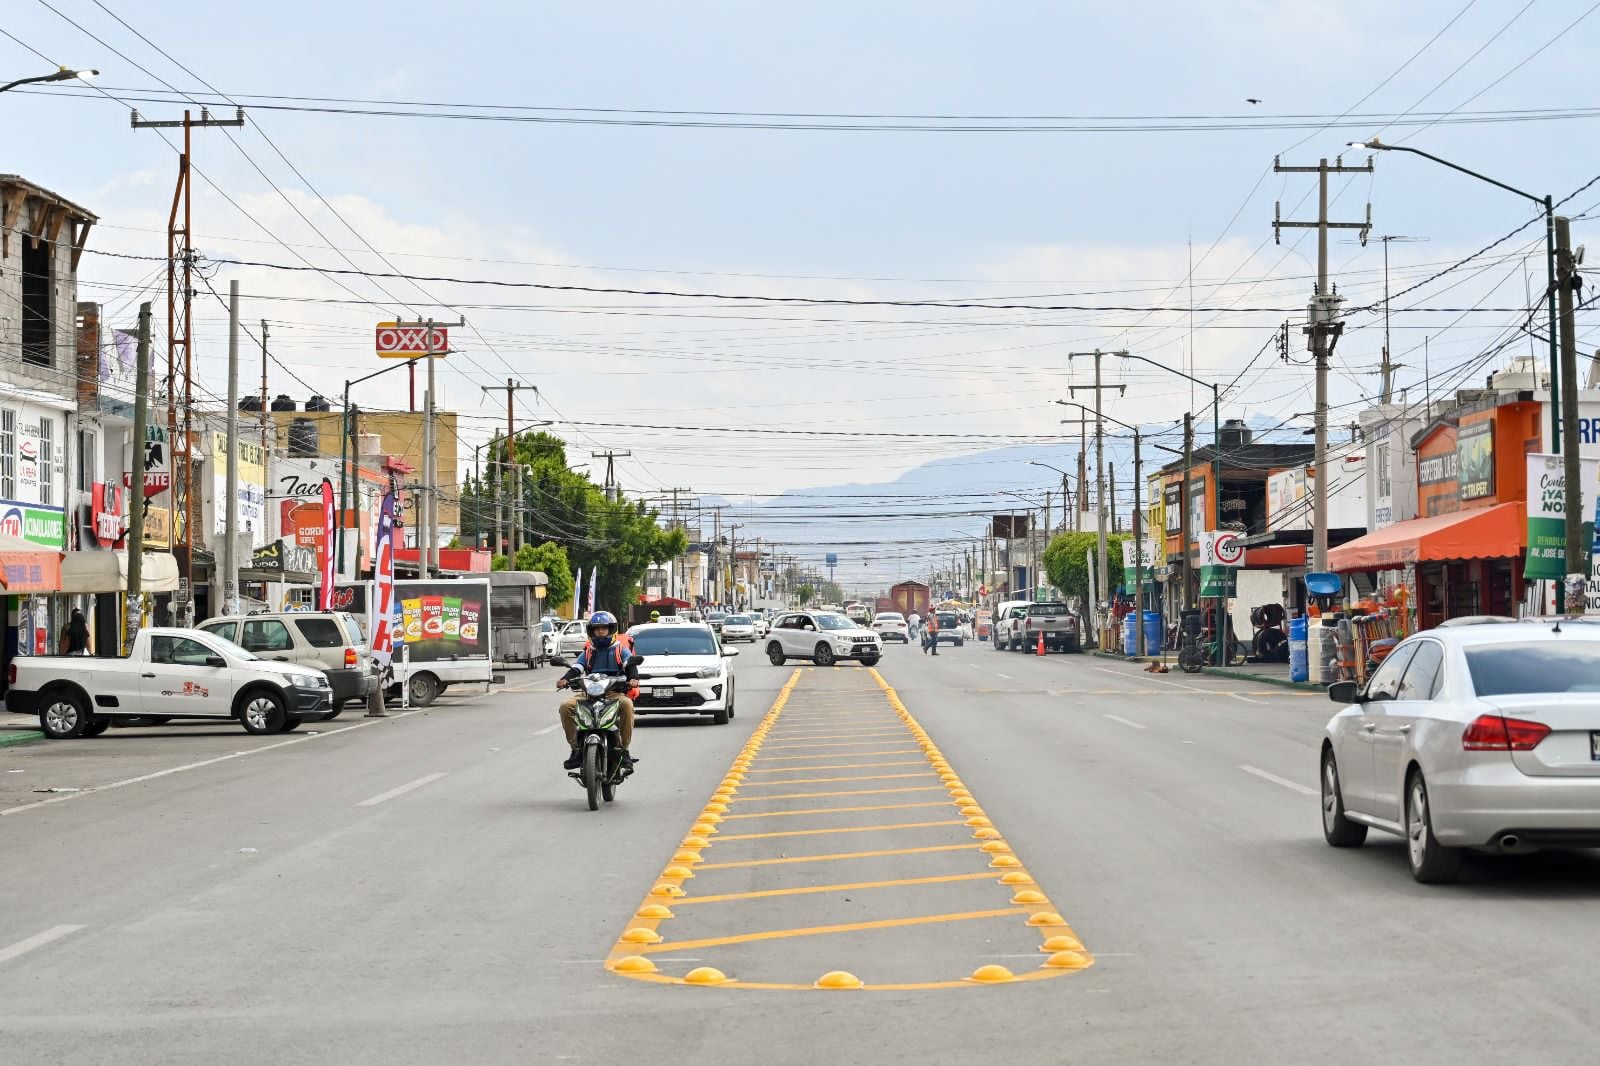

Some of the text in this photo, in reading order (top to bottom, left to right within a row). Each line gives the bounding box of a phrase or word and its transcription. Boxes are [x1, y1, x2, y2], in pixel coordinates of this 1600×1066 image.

[378, 330, 445, 349] OXXO
[124, 473, 168, 486] TATE
[1467, 481, 1488, 497] TRUPER
